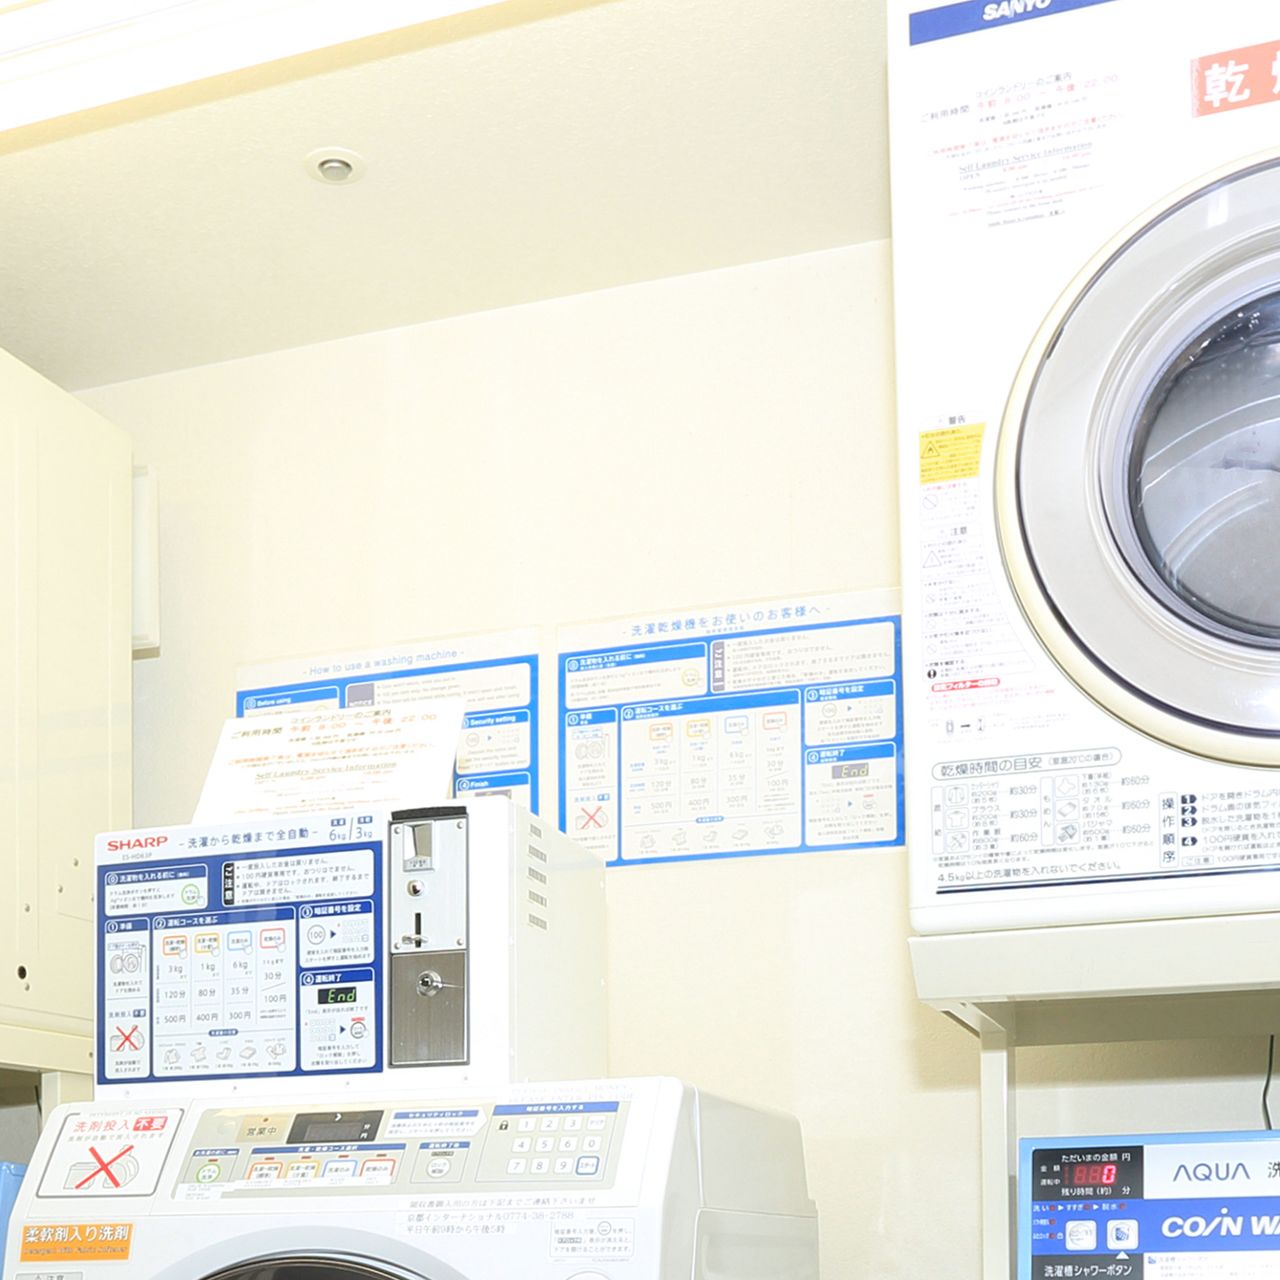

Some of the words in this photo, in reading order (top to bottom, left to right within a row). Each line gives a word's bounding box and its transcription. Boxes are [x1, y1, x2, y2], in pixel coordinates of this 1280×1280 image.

[631, 605, 821, 636] 洗濯乾燥機をお使いのお客様へ
[940, 756, 1043, 778] 乾燥時間の目安
[108, 836, 168, 852] SHARP
[187, 827, 310, 849] 洗濯から乾燥まで全自動
[327, 988, 357, 1003] End
[73, 1116, 131, 1133] 洗剤投入
[135, 1115, 169, 1132] 不要
[245, 1125, 278, 1138] 営業中
[1061, 1152, 1118, 1163] ただいまの金額
[1121, 1152, 1131, 1162] 円
[1173, 1162, 1251, 1182] AQUA
[1121, 1186, 1131, 1196] 分
[24, 1224, 129, 1243] 柔軟剤入り洗剤
[1044, 1264, 1133, 1278] 洗濯槽シャワーボタン
